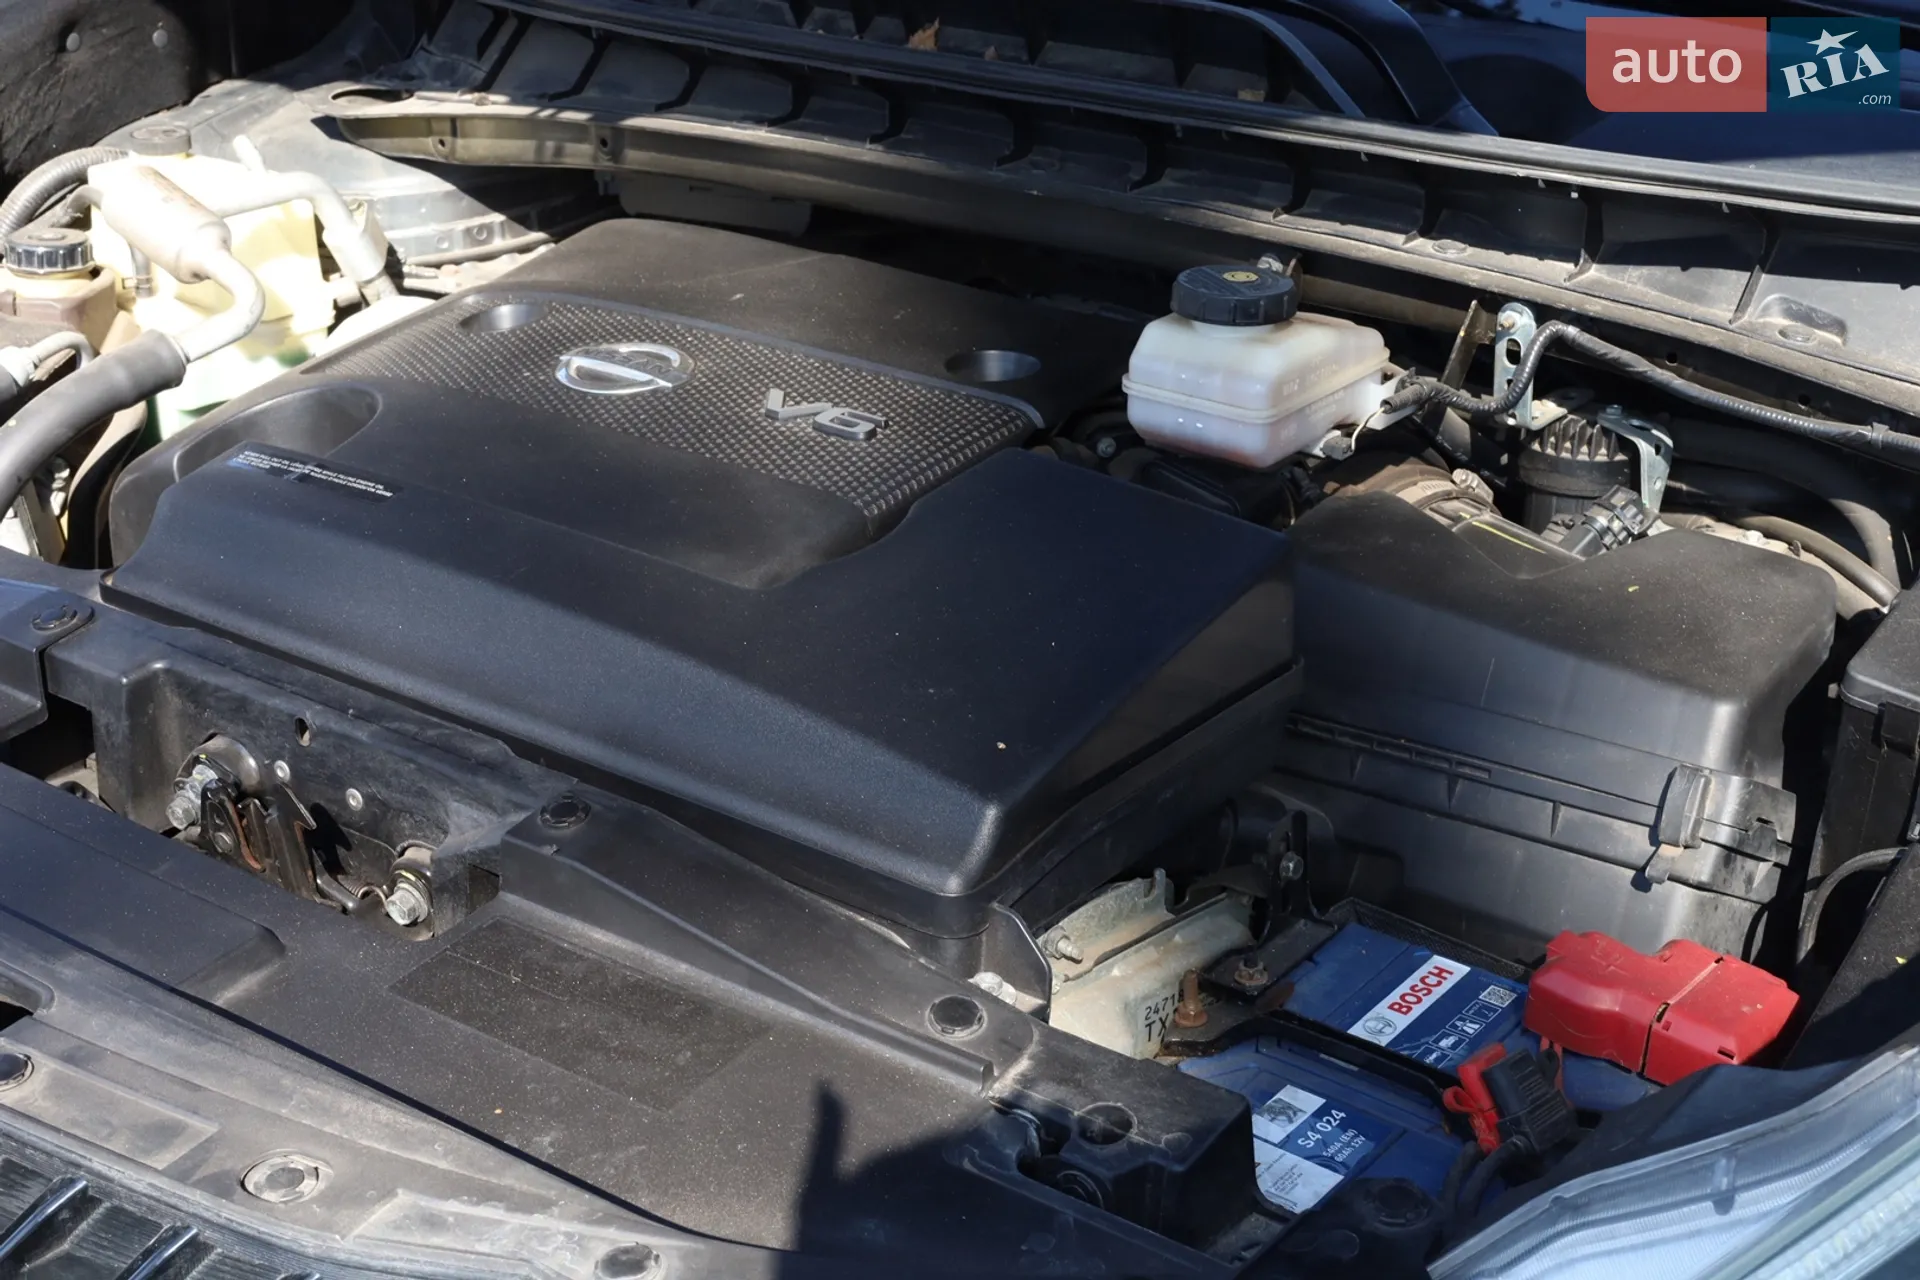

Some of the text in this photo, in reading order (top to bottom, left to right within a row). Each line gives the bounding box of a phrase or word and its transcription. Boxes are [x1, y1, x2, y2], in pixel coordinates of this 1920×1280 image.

[765, 388, 889, 441] V6
[1387, 965, 1454, 1016] BOSCH
[1298, 1109, 1347, 1148] S4 024
[1350, 1135, 1366, 1149] 12V
